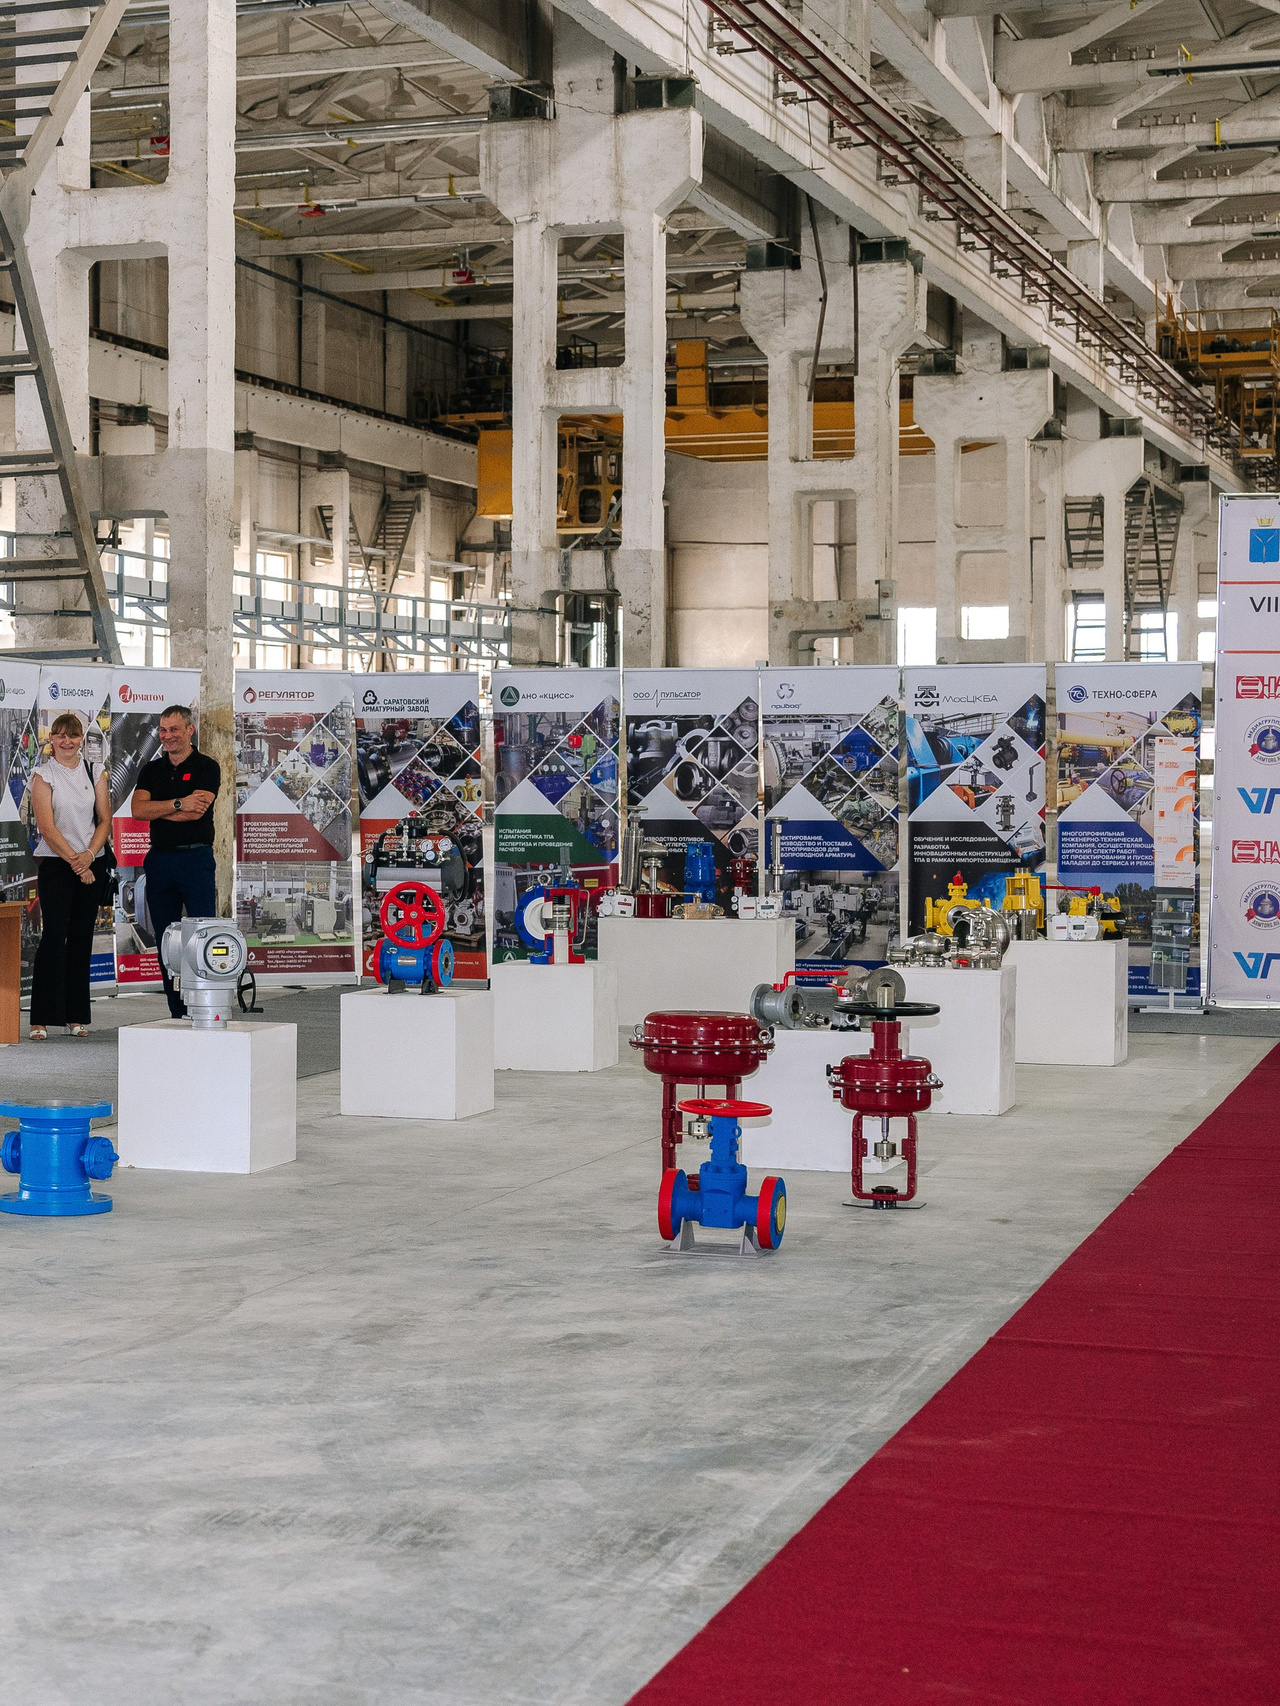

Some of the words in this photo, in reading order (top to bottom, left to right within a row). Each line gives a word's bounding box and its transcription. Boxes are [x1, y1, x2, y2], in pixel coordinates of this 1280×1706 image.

[61, 688, 94, 697] ТЕХНО-СФЕРА
[1092, 690, 1157, 699] ТЕХНО-СФЕРА
[942, 695, 998, 703] МосЦКБА
